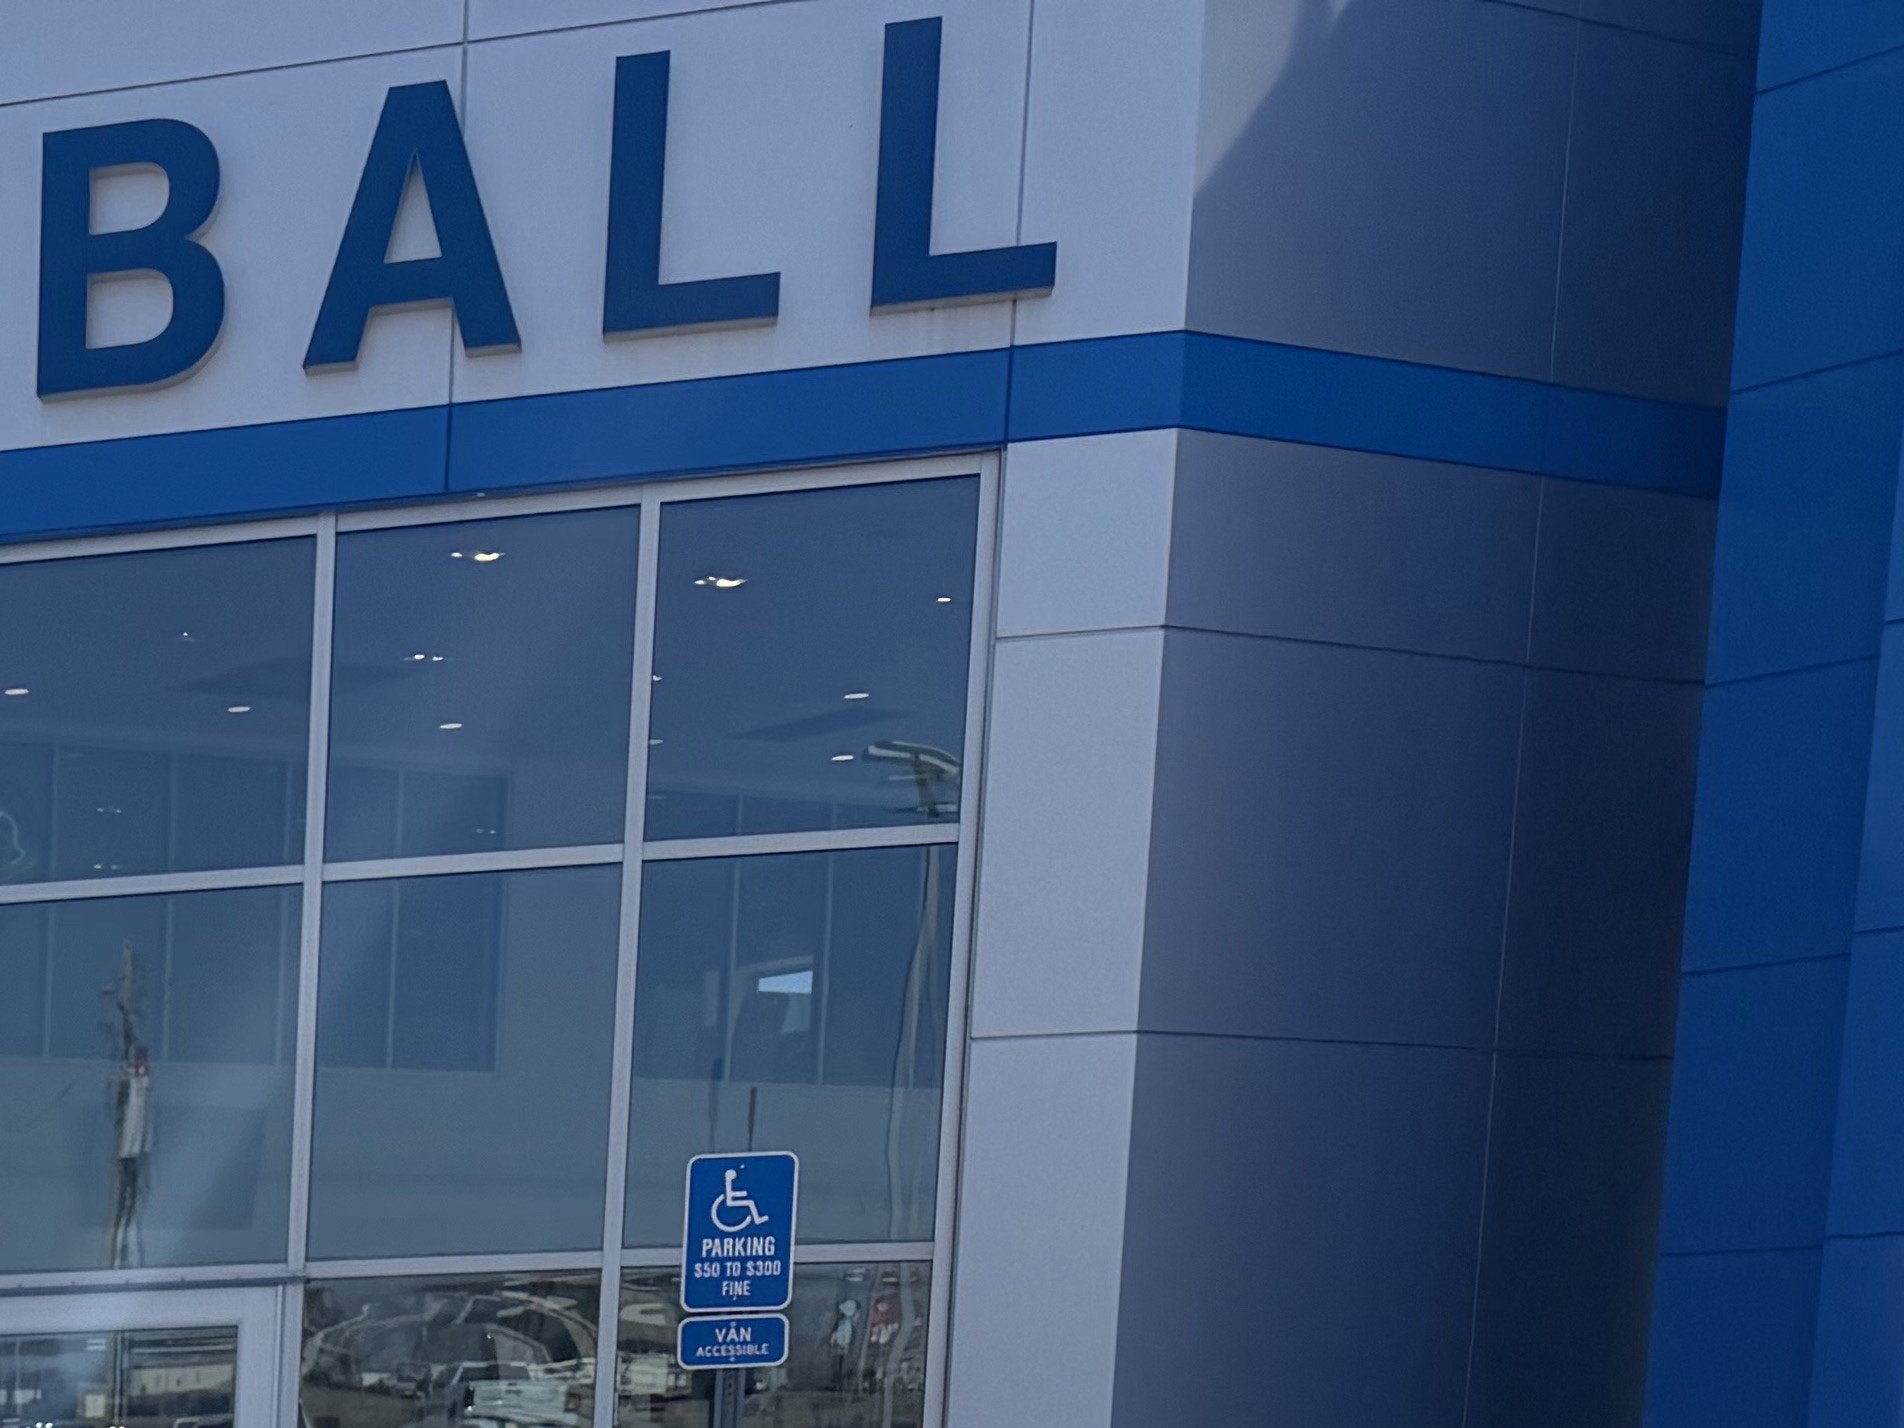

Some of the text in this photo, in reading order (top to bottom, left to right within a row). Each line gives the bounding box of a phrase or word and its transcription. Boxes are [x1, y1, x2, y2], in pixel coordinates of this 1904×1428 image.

[36, 14, 1060, 404] BALL
[702, 1236, 776, 1258] PARKING
[694, 1260, 782, 1278] $50 TO $300
[722, 1280, 751, 1296] FINE
[714, 1326, 752, 1343] VAN
[695, 1342, 770, 1358] ACCESSIBLE
